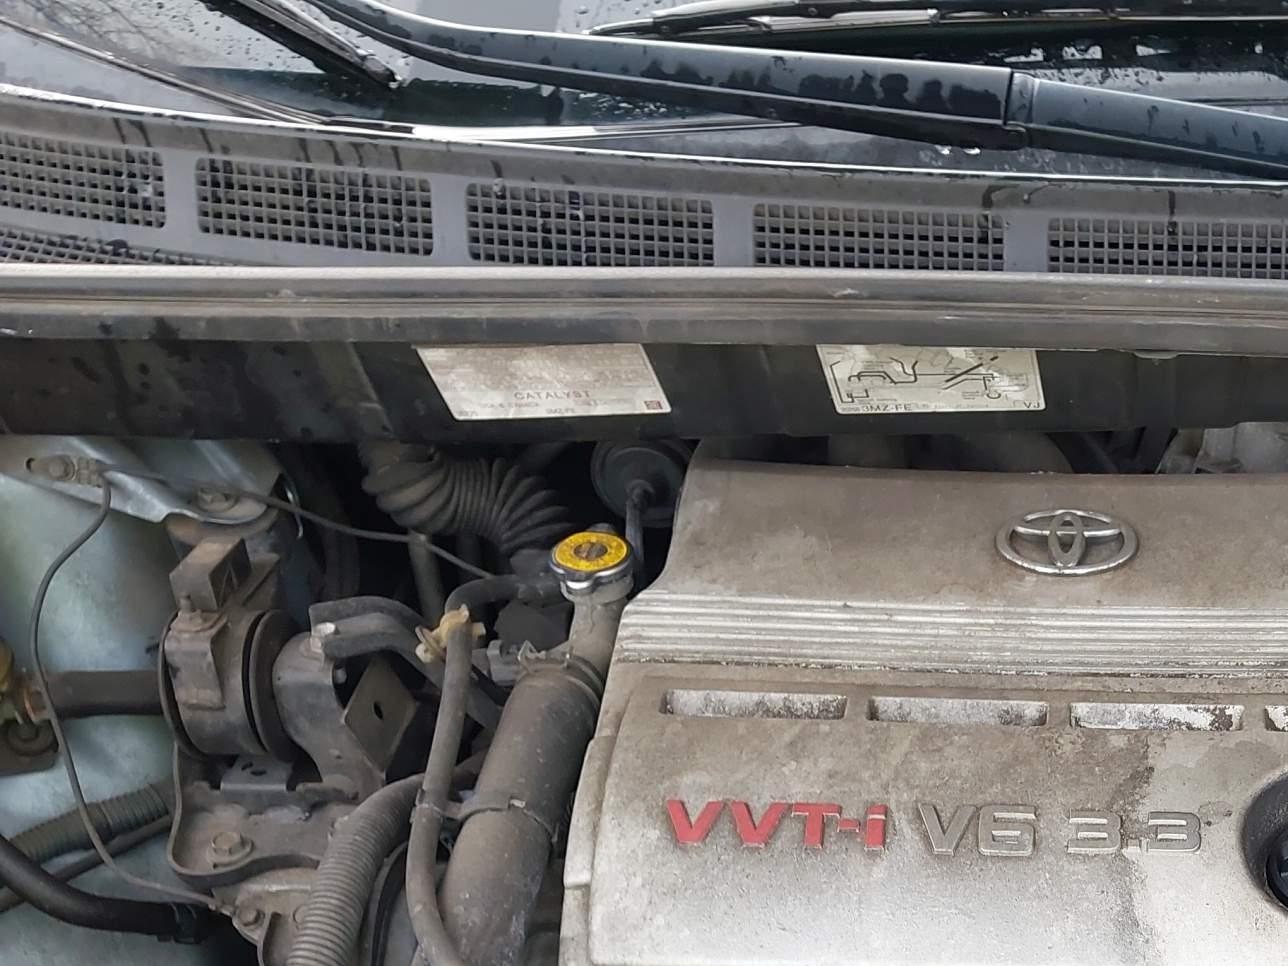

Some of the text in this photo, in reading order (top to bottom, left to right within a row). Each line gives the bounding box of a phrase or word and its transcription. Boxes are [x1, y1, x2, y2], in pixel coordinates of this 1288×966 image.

[513, 390, 591, 401] CATALYST
[1024, 401, 1040, 409] VJ
[667, 799, 1201, 856] VVT-i V6 3.3
